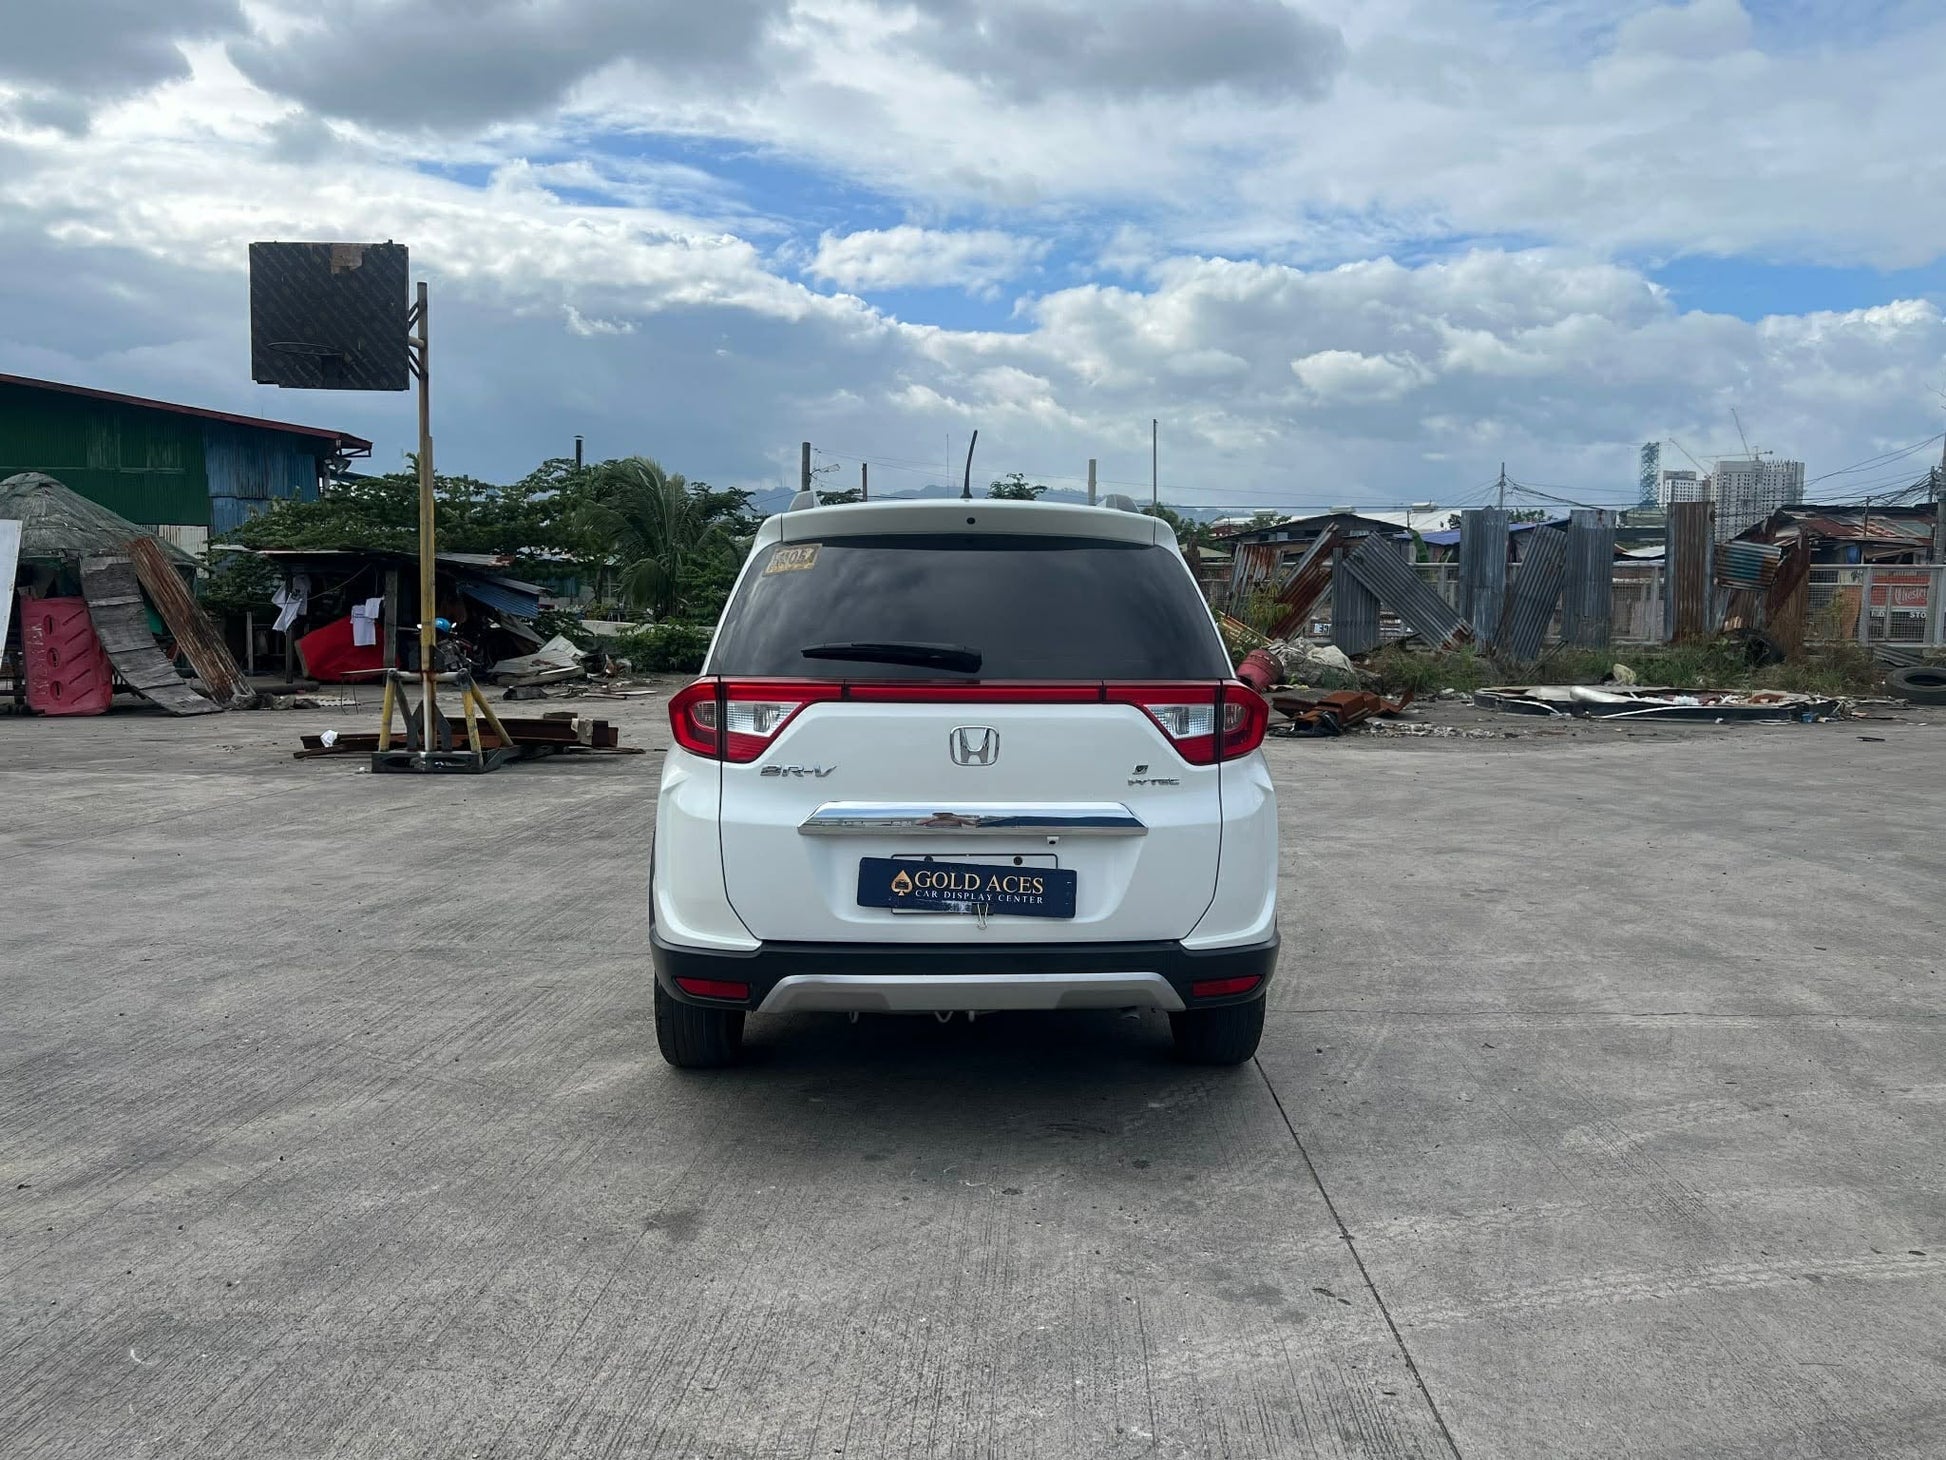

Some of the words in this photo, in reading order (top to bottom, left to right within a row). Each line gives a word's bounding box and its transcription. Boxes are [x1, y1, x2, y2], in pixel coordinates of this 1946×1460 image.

[760, 765, 837, 778] BR-V
[914, 870, 981, 891] GOLD
[986, 874, 1044, 895] ACES
[915, 889, 938, 898] CAR
[943, 891, 992, 901] DISPLAY
[998, 894, 1043, 904] CENTER
